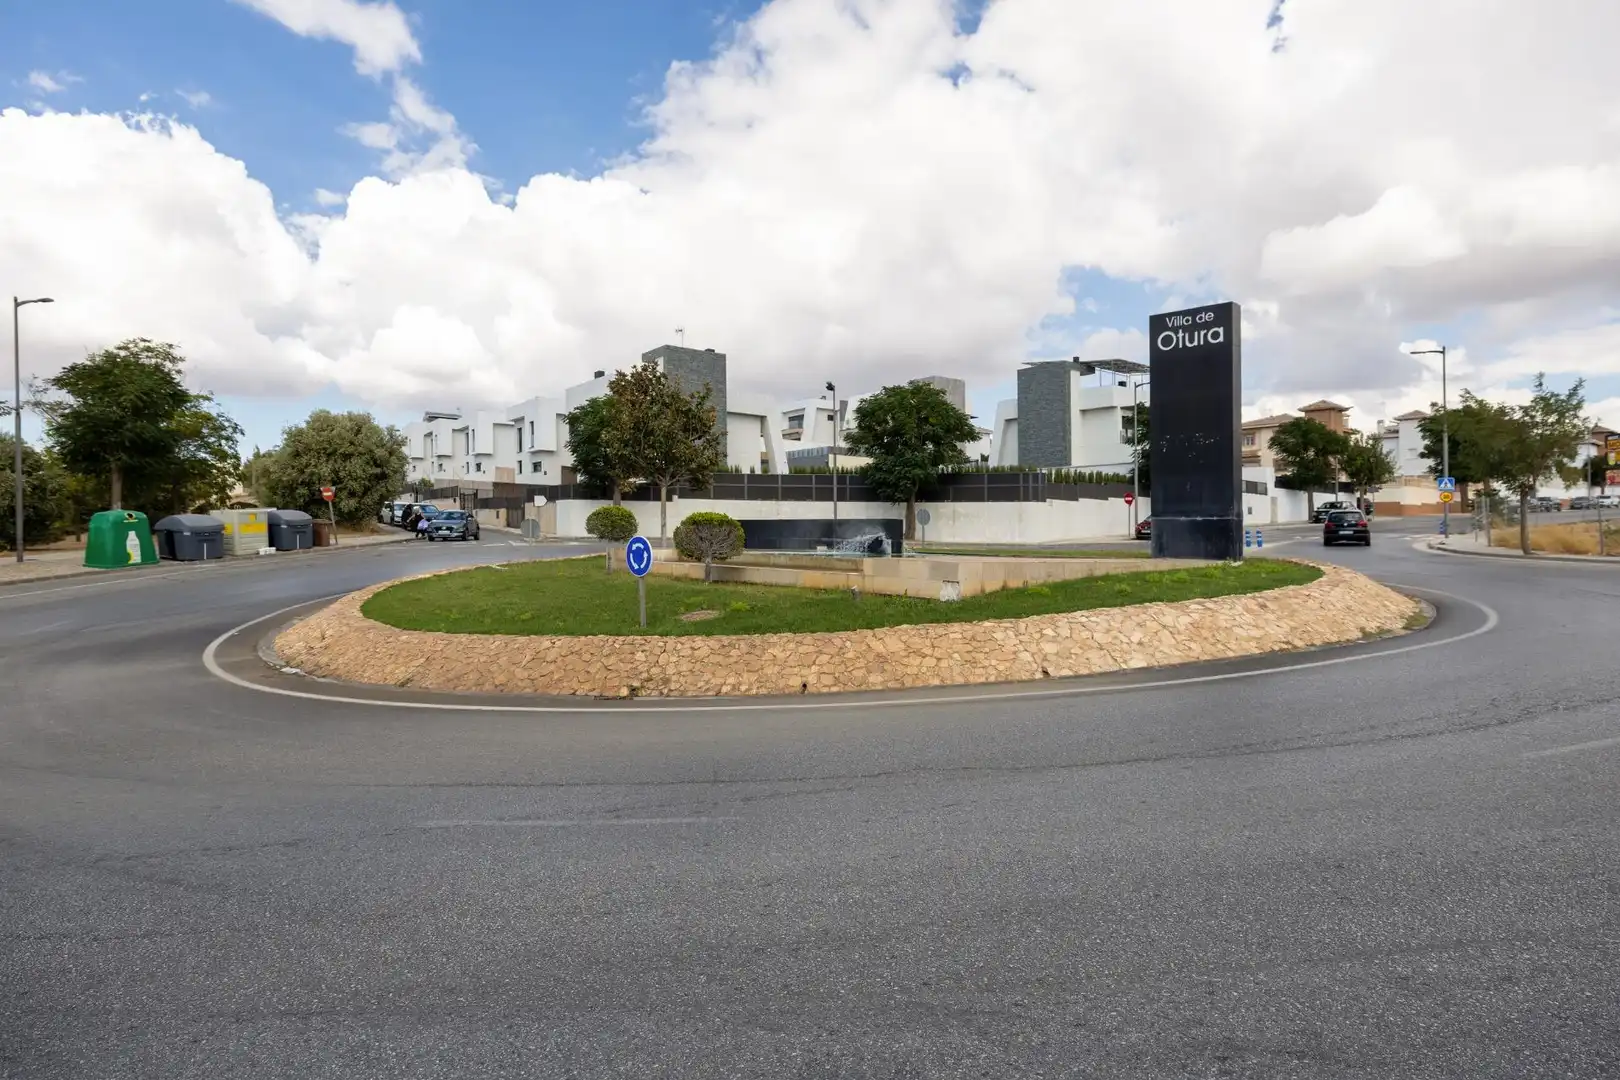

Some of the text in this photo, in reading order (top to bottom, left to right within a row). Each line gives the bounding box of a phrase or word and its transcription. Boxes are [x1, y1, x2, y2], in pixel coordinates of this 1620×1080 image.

[1166, 312, 1214, 328] Villa de
[1157, 326, 1224, 351] Otura
